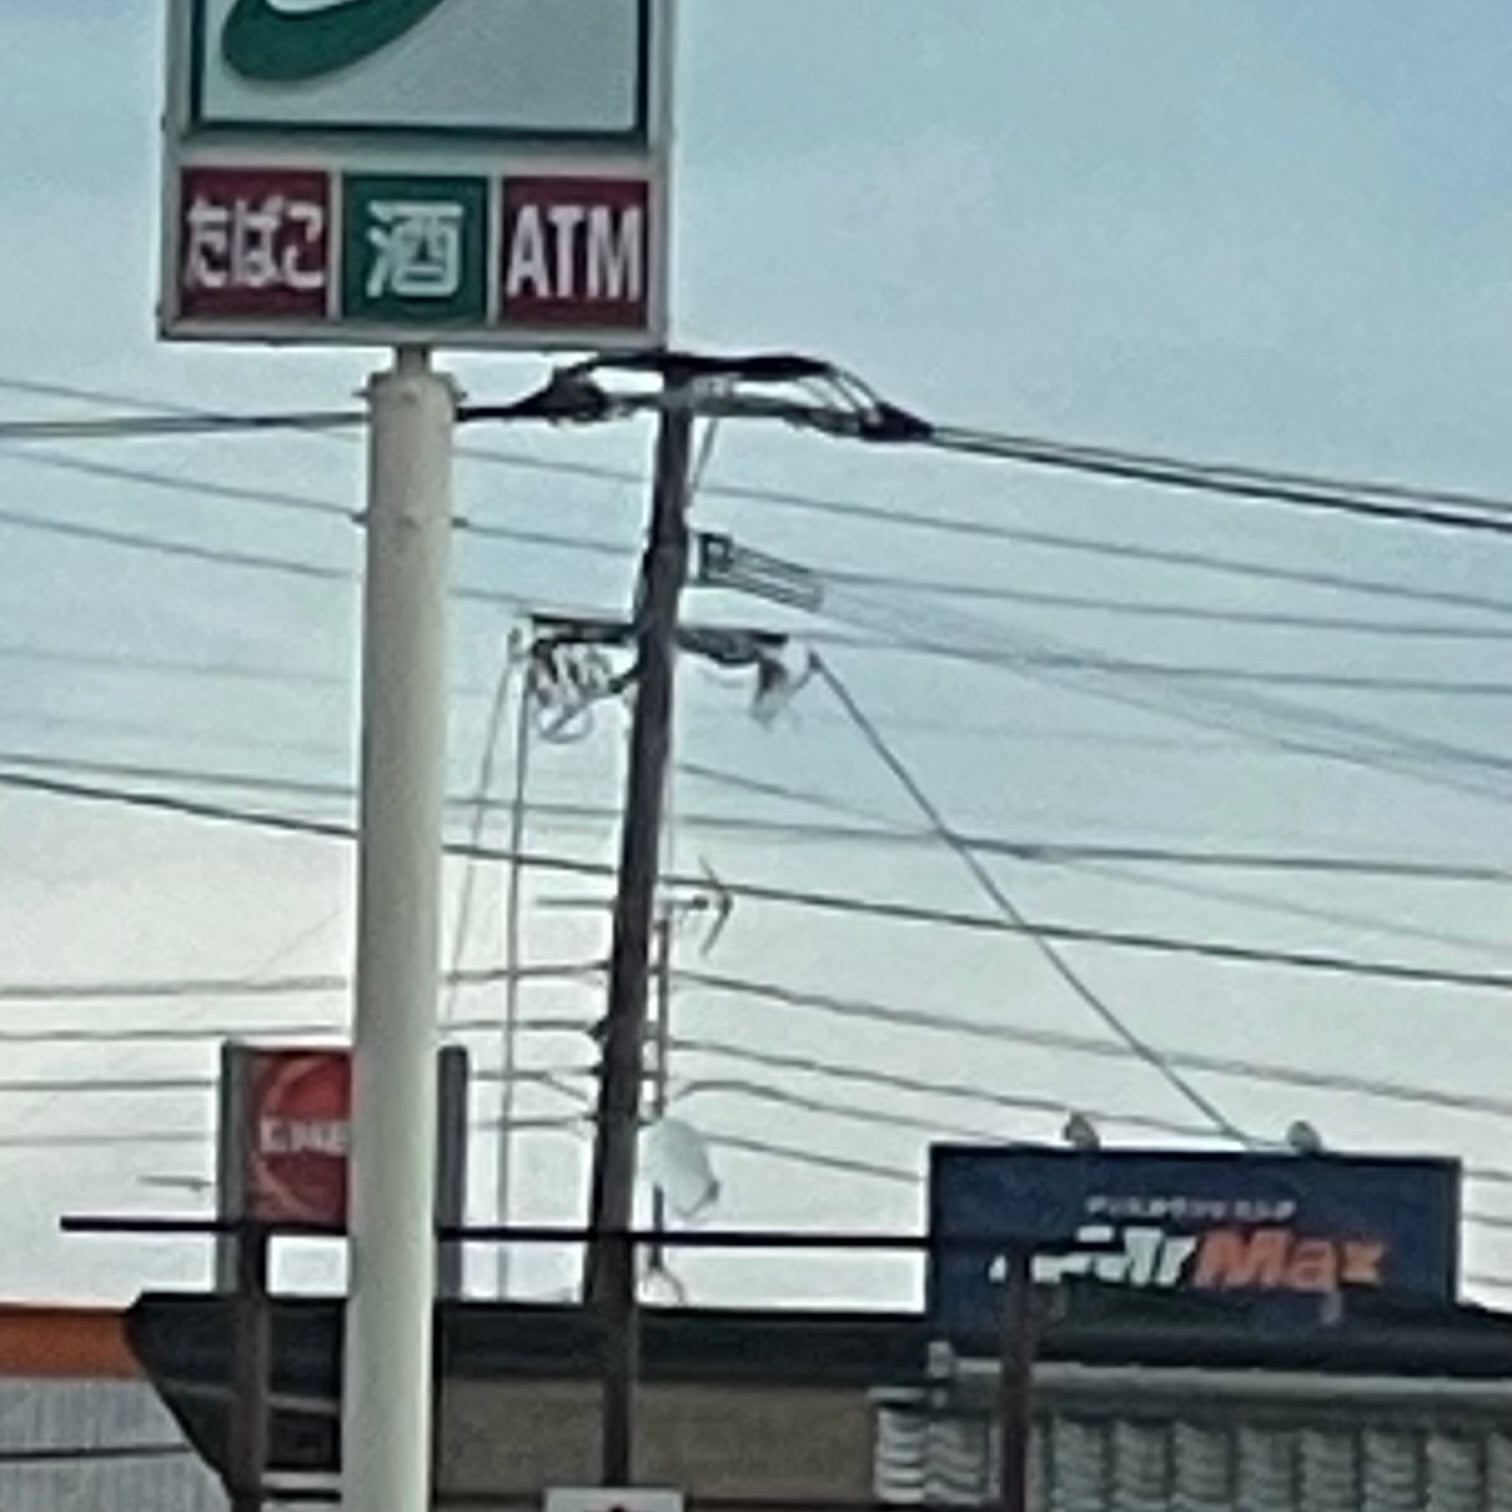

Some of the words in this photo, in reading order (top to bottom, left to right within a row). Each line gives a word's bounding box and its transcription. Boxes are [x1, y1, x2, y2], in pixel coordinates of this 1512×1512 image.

[184, 195, 327, 289] たばこ
[367, 199, 464, 299] 酒
[506, 203, 643, 303] ATM
